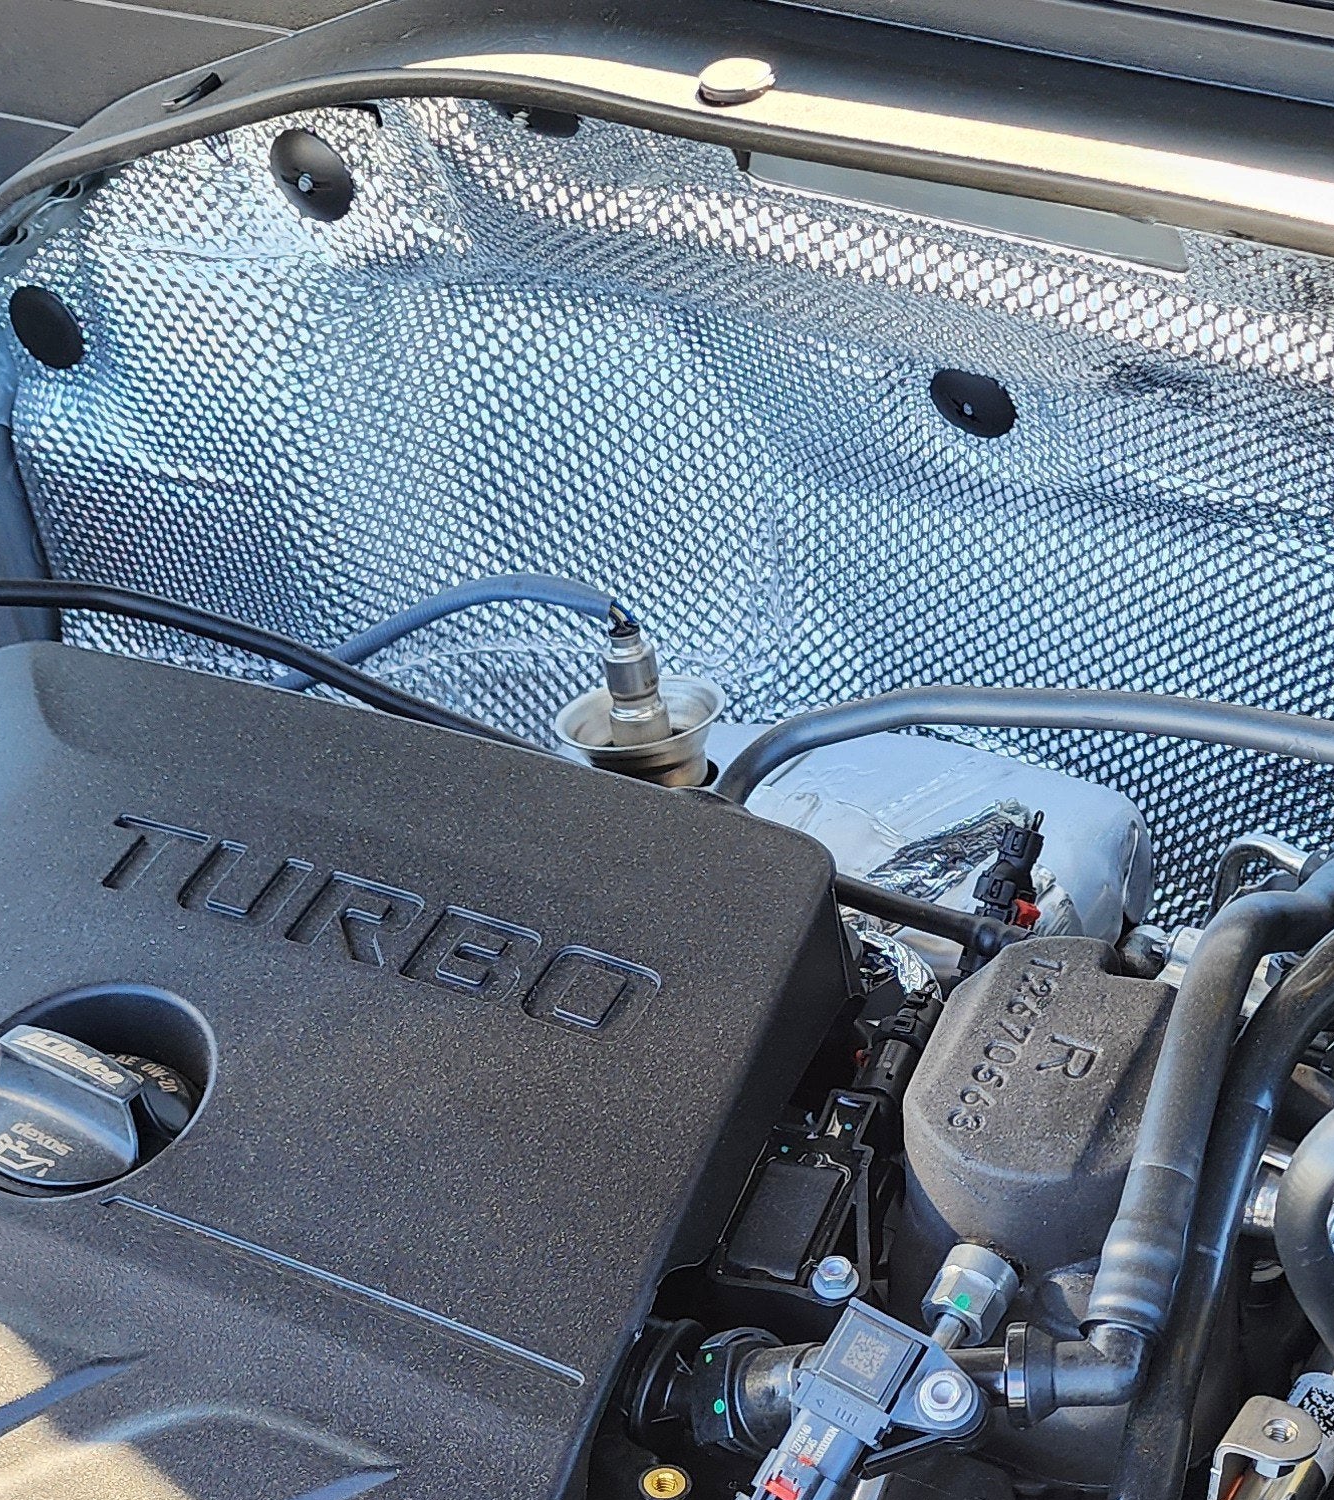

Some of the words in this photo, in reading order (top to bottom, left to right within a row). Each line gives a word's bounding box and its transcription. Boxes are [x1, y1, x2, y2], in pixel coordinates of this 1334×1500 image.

[101, 812, 662, 1044] TURBO
[17, 1032, 124, 1084] ACDelco
[141, 1063, 178, 1092] 0W-20
[1035, 1033, 1104, 1079] R
[10, 1122, 74, 1157] dexos
